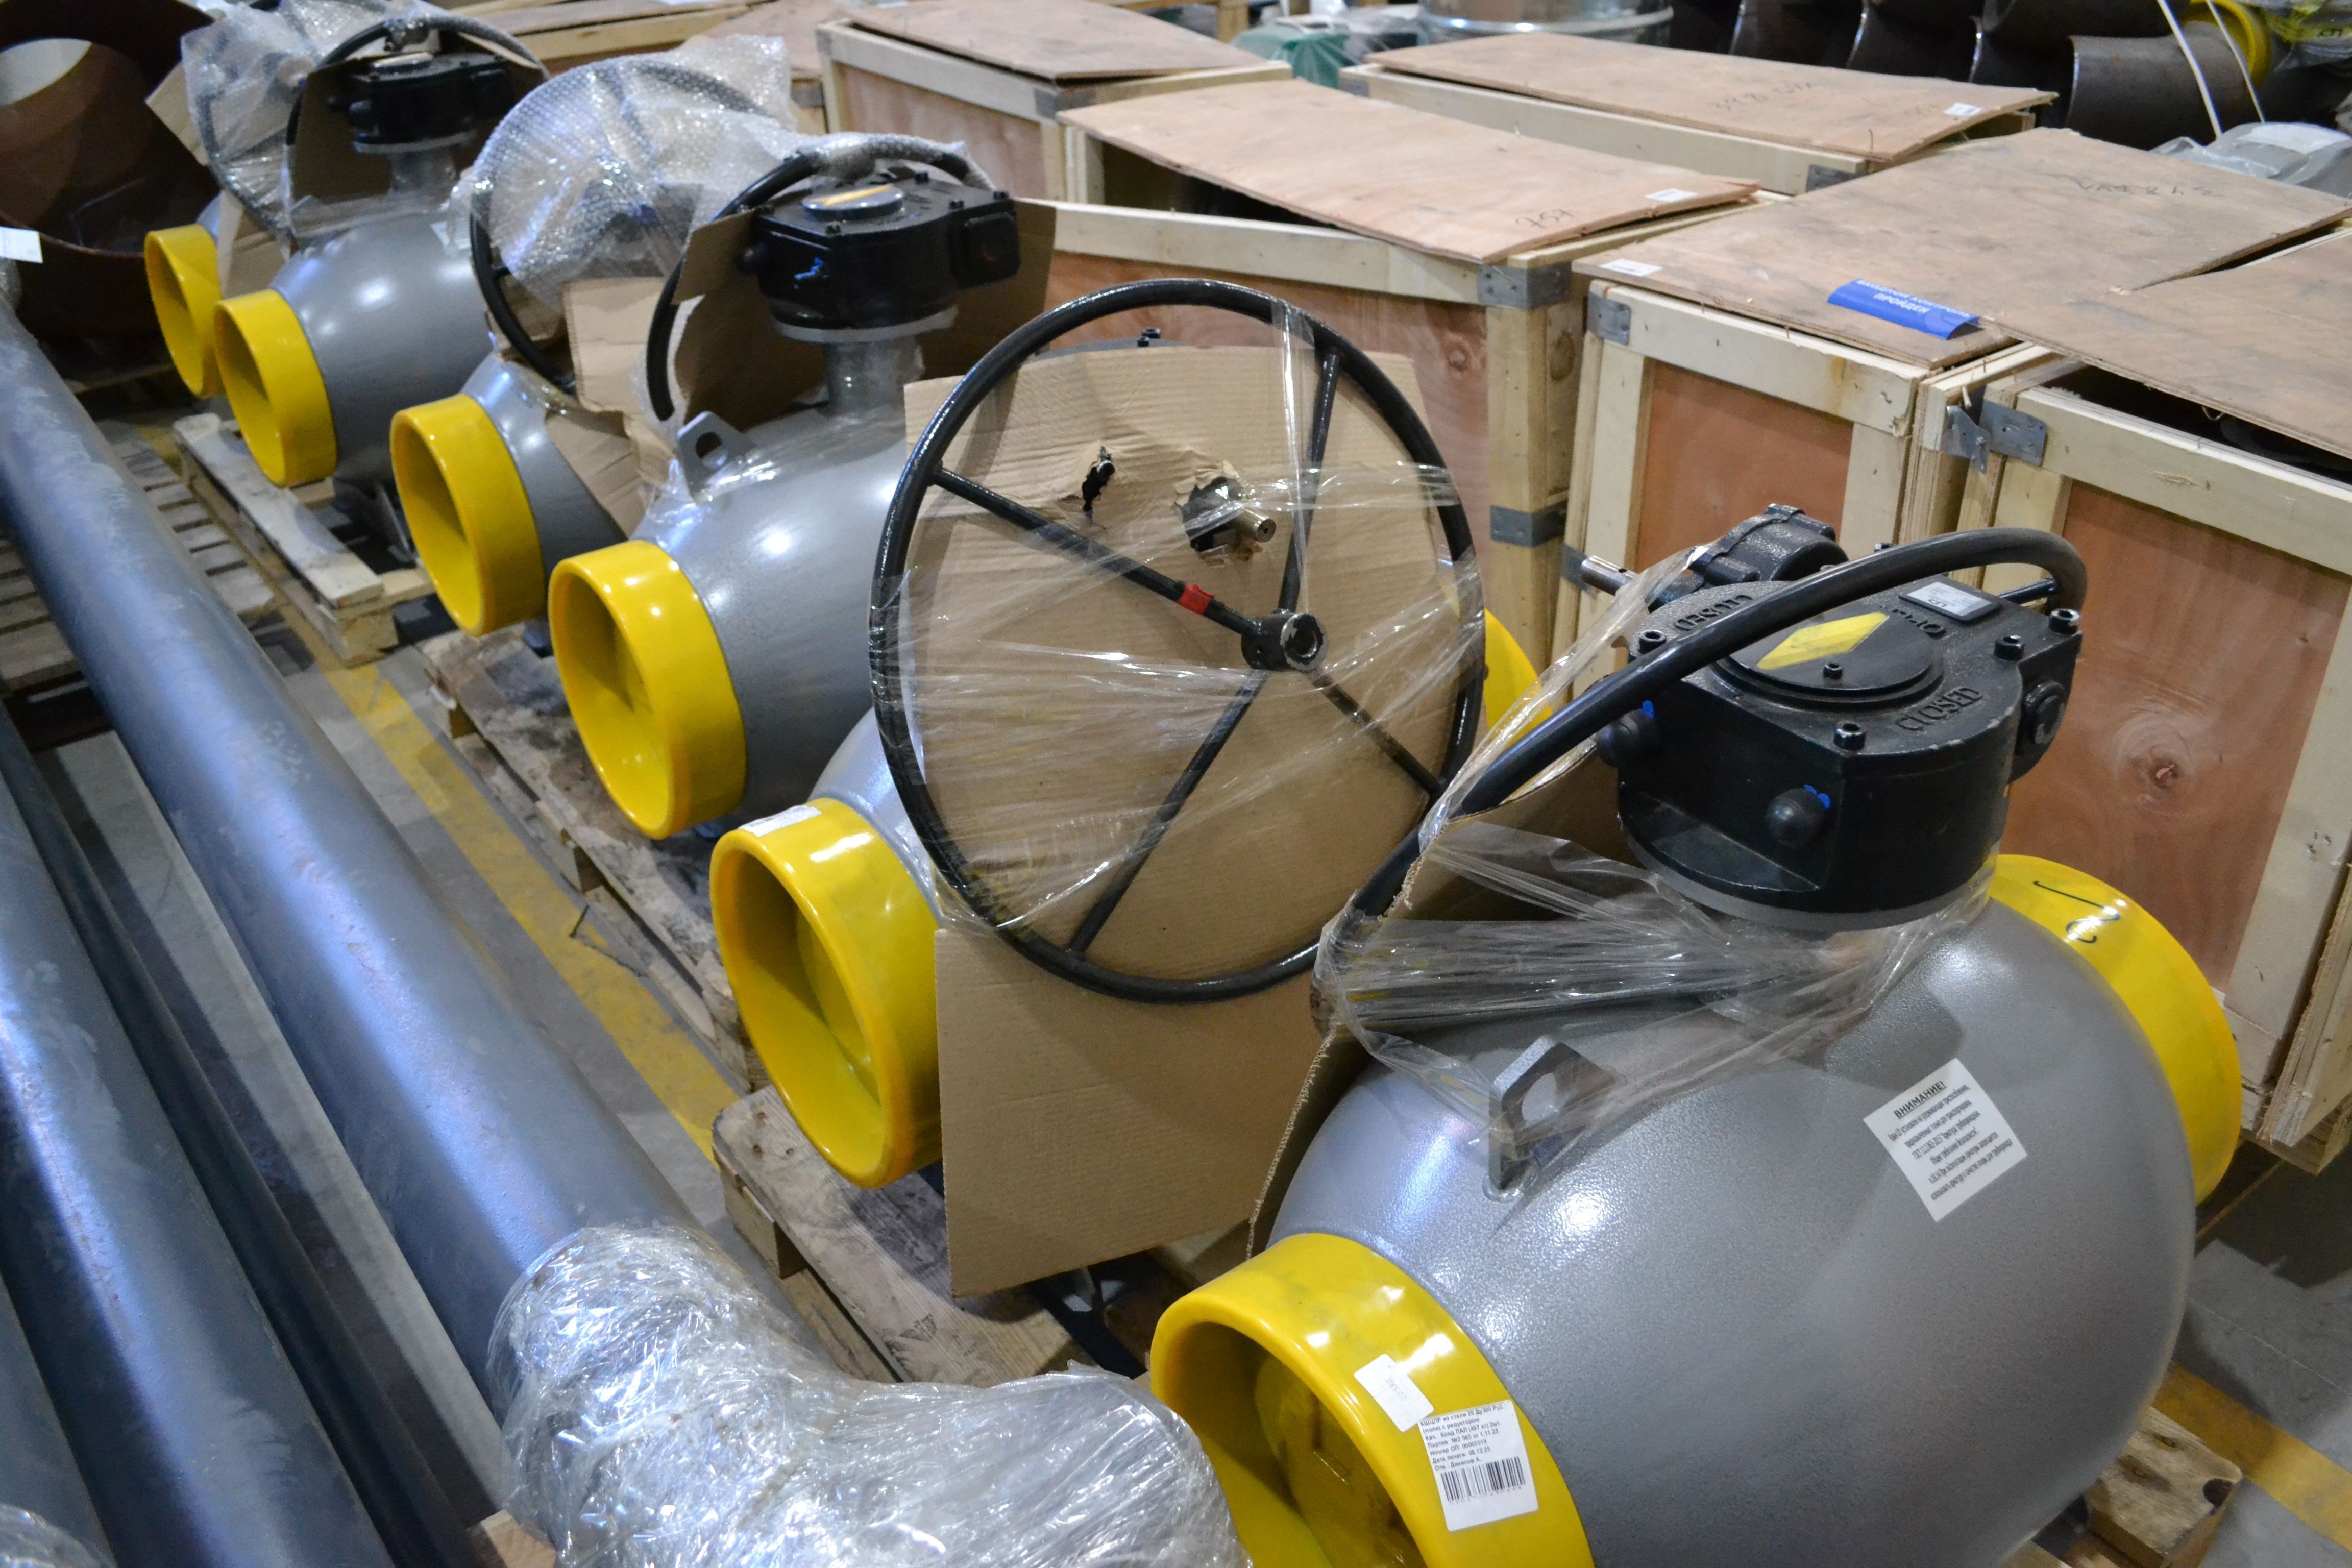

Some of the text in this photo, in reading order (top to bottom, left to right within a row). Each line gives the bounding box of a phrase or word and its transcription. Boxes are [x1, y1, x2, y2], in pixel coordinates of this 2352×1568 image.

[1895, 687, 1983, 731] CLOSED
[1893, 1079, 1946, 1119] ВНИМАНИЕ!
[1450, 1412, 1466, 1420] стали
[1446, 1417, 1480, 1429] редуктором
[1430, 1447, 1450, 1456] Номер
[1432, 1456, 1446, 1464] Дата
